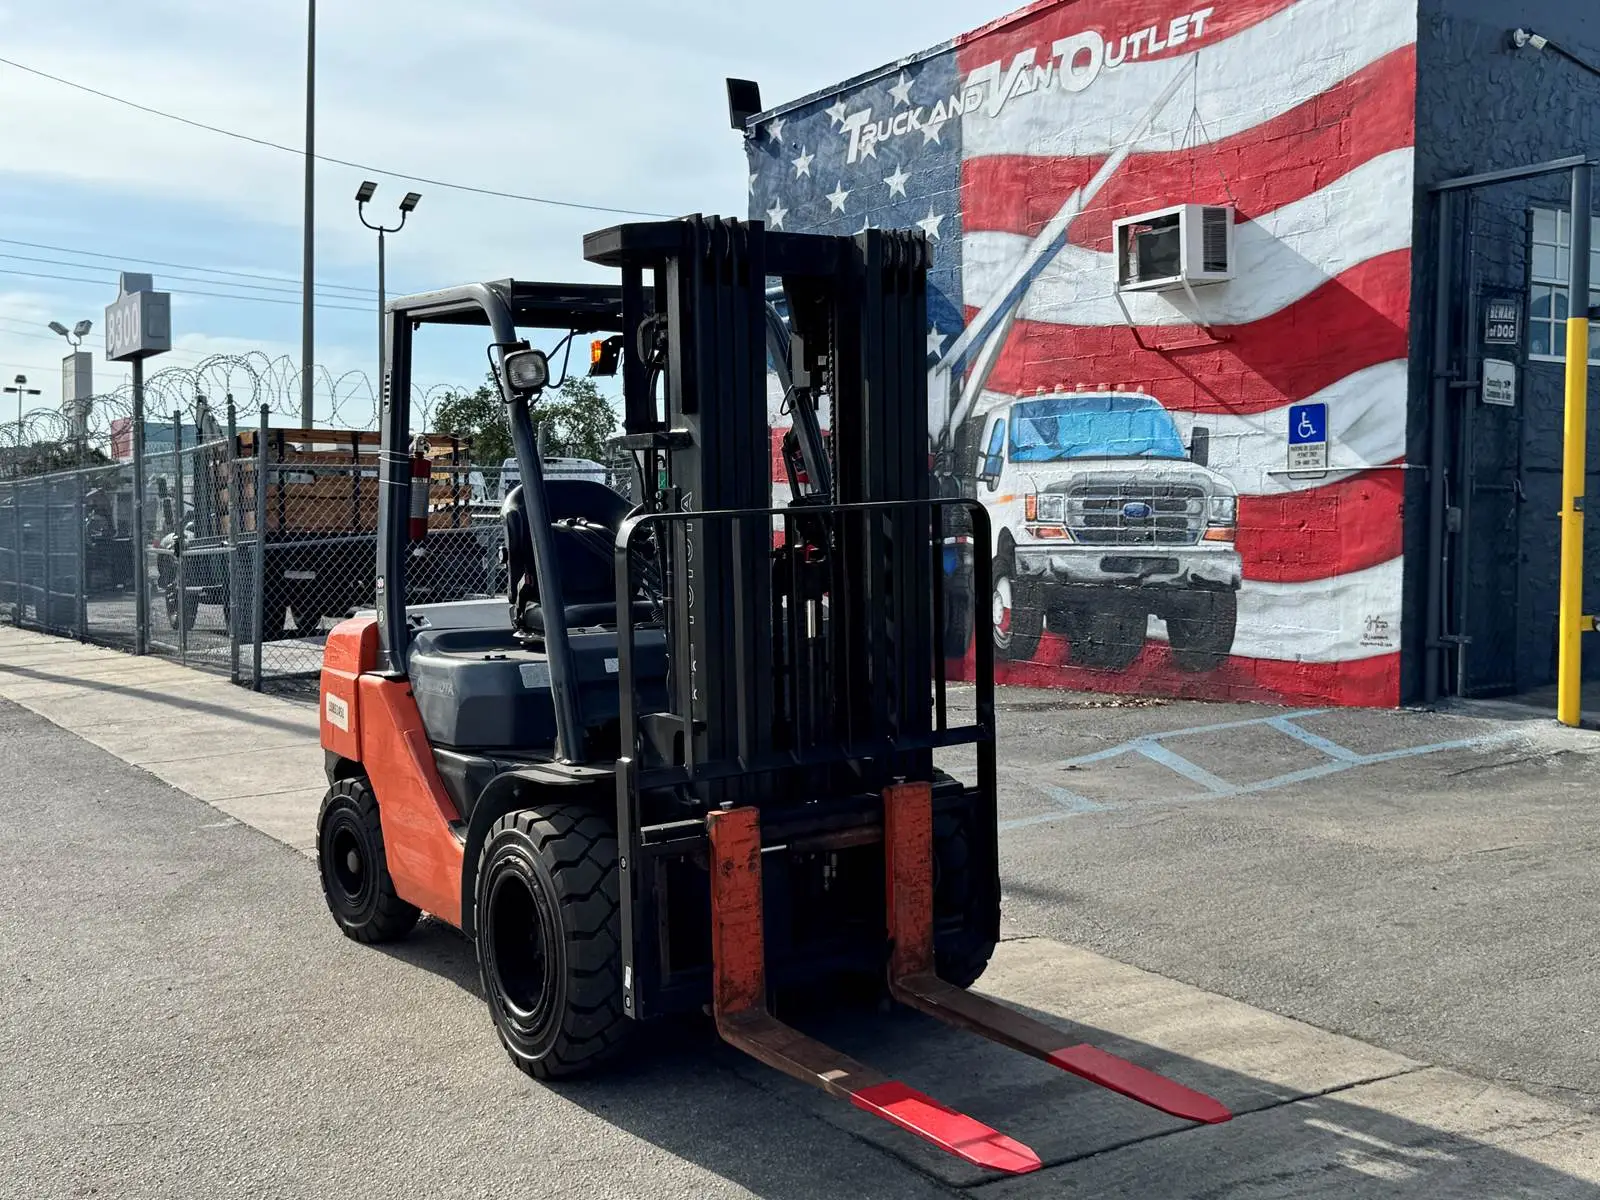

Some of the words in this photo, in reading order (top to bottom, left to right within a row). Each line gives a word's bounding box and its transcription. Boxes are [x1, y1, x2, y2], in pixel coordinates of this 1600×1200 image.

[839, 107, 923, 164] TRUCK
[927, 86, 983, 125] AND
[965, 47, 1053, 118] VAN
[1052, 7, 1215, 92] OUTLET
[107, 302, 139, 353] 8300
[1497, 325, 1515, 338] DOG
